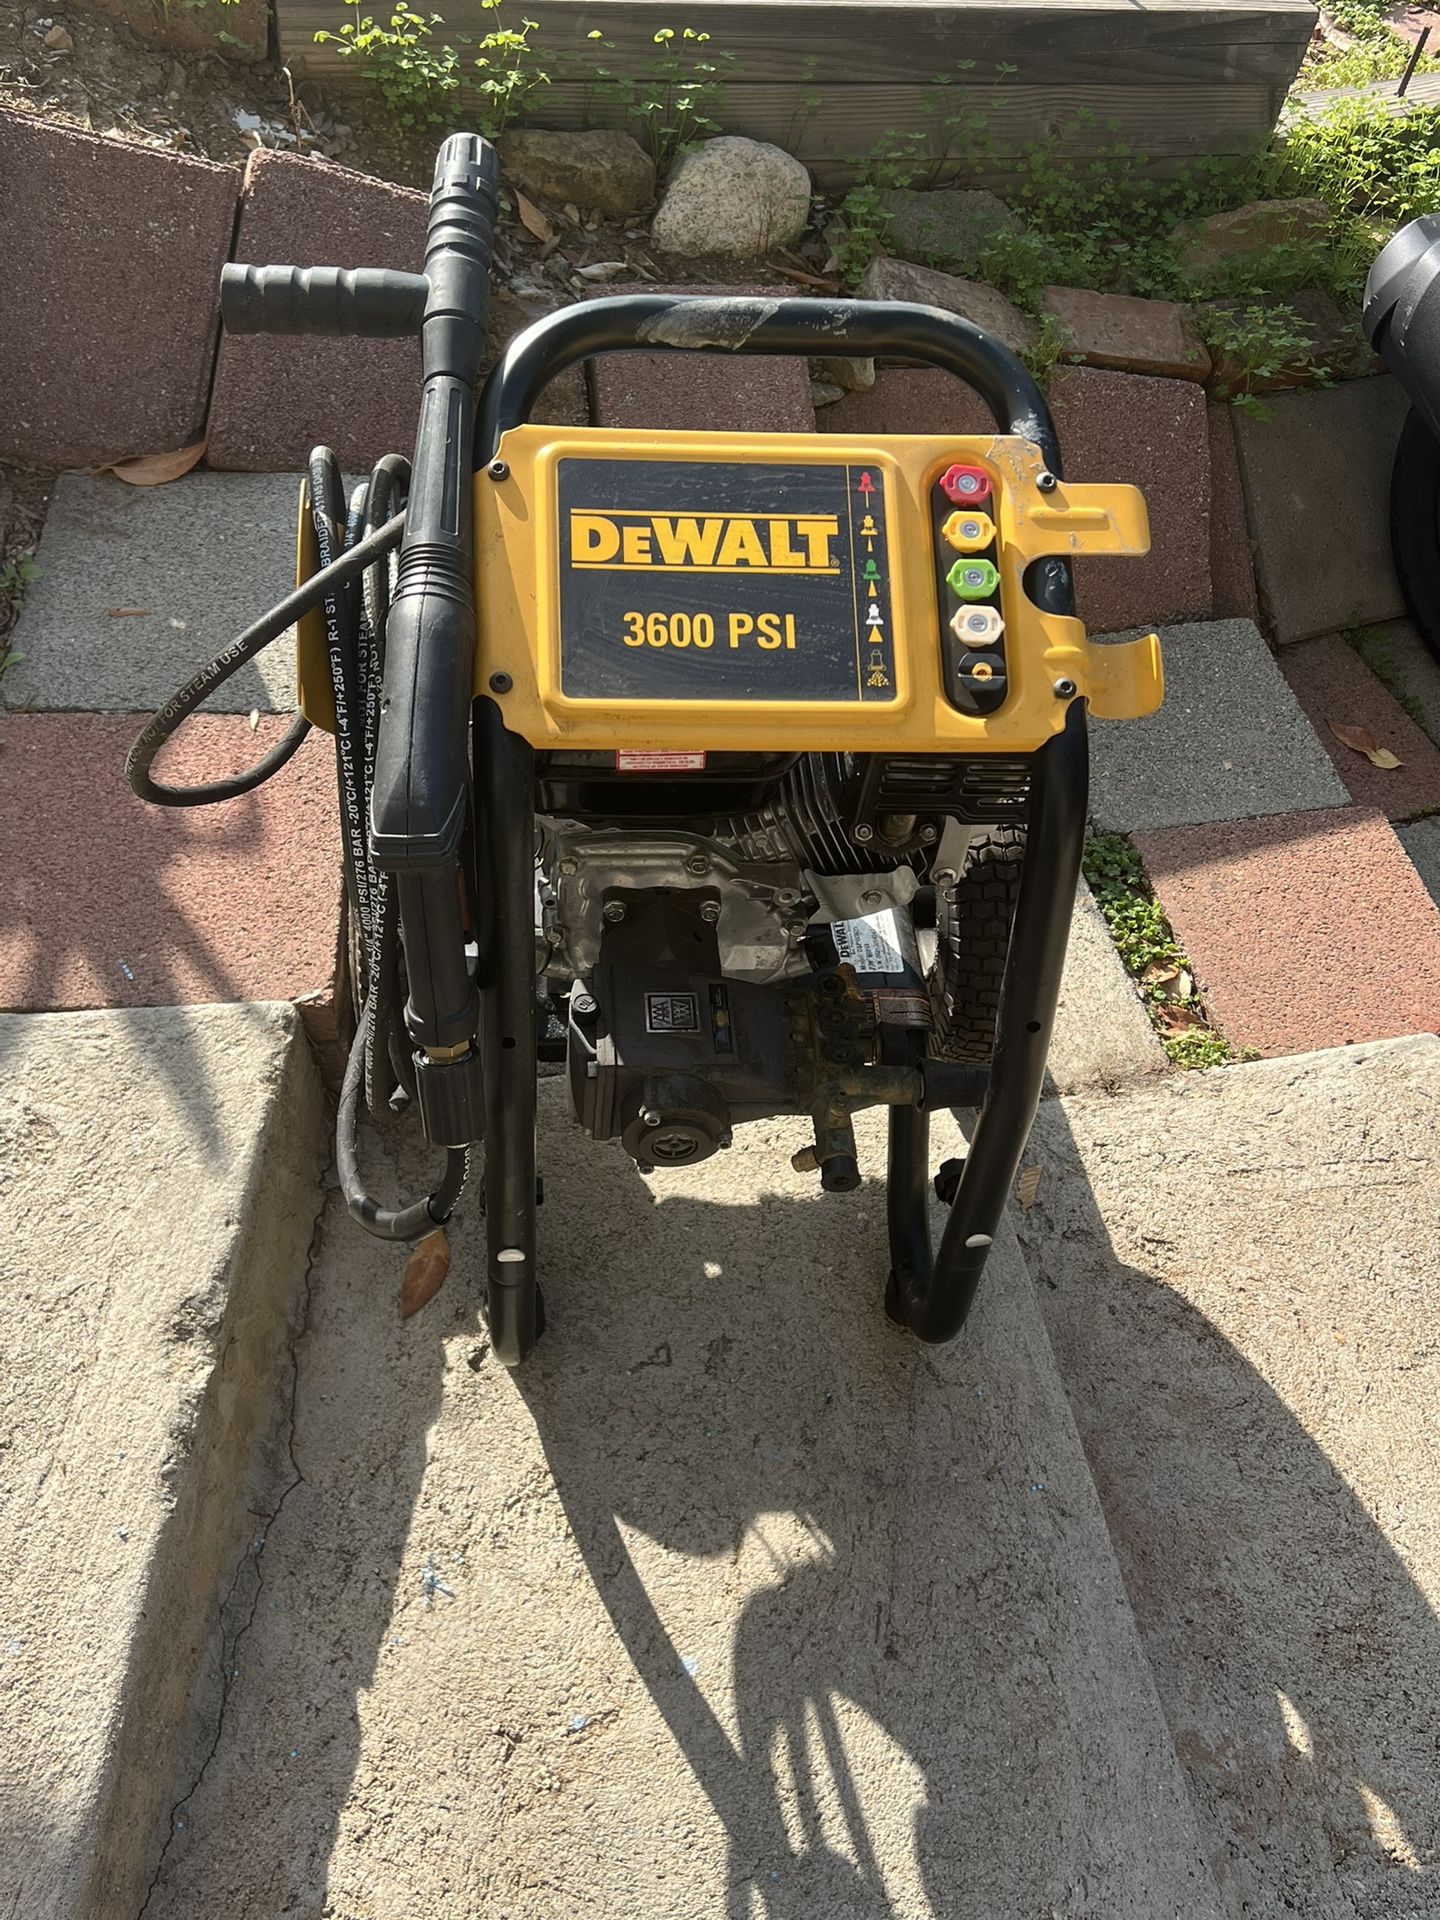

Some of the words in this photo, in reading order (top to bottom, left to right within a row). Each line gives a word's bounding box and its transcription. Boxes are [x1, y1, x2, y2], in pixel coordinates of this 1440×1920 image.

[316, 511, 332, 567] BRAIDED
[570, 517, 839, 569] DEWALT
[328, 619, 339, 641] R-1
[623, 611, 714, 649] 3600
[729, 612, 796, 650] PSI
[158, 700, 182, 725] FOR
[179, 662, 222, 702] STEAM
[219, 638, 249, 667] USE
[357, 662, 367, 693] FOR
[351, 828, 364, 857] BAR
[354, 860, 368, 904] PSI/276
[361, 906, 372, 932] 4000
[834, 919, 850, 958] DEWAL
[369, 984, 380, 1010] BAR
